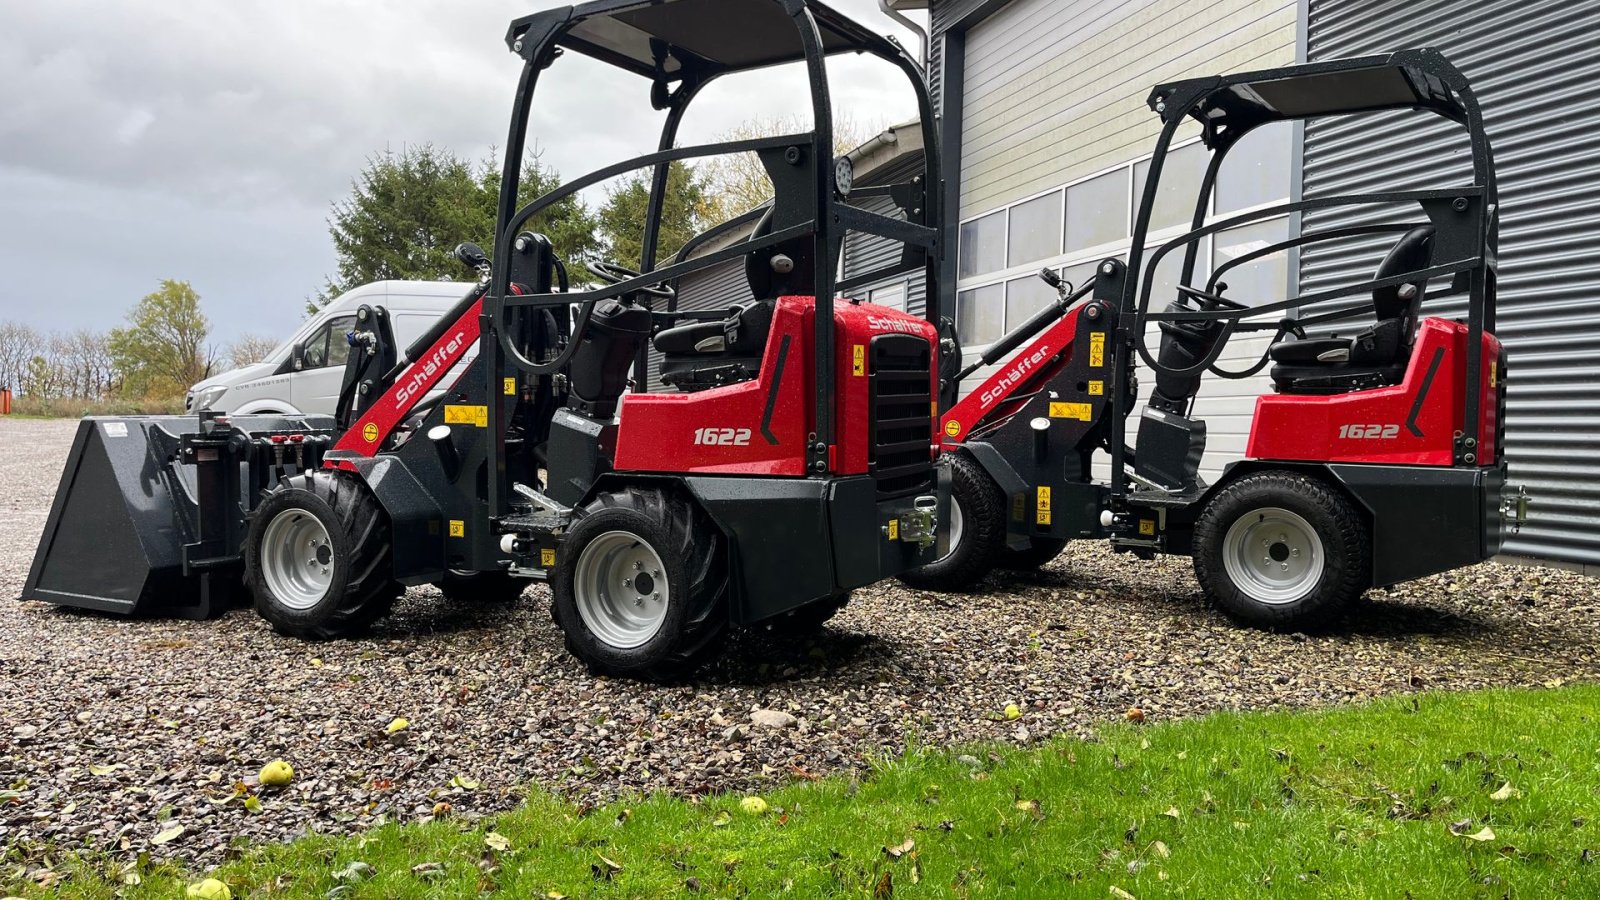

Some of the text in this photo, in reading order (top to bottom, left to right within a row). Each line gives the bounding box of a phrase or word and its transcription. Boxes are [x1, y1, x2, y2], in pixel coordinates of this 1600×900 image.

[395, 332, 464, 409] Schäffer
[980, 345, 1048, 409] Schäffer
[694, 428, 752, 446] 1622
[1339, 424, 1400, 439] 1622
